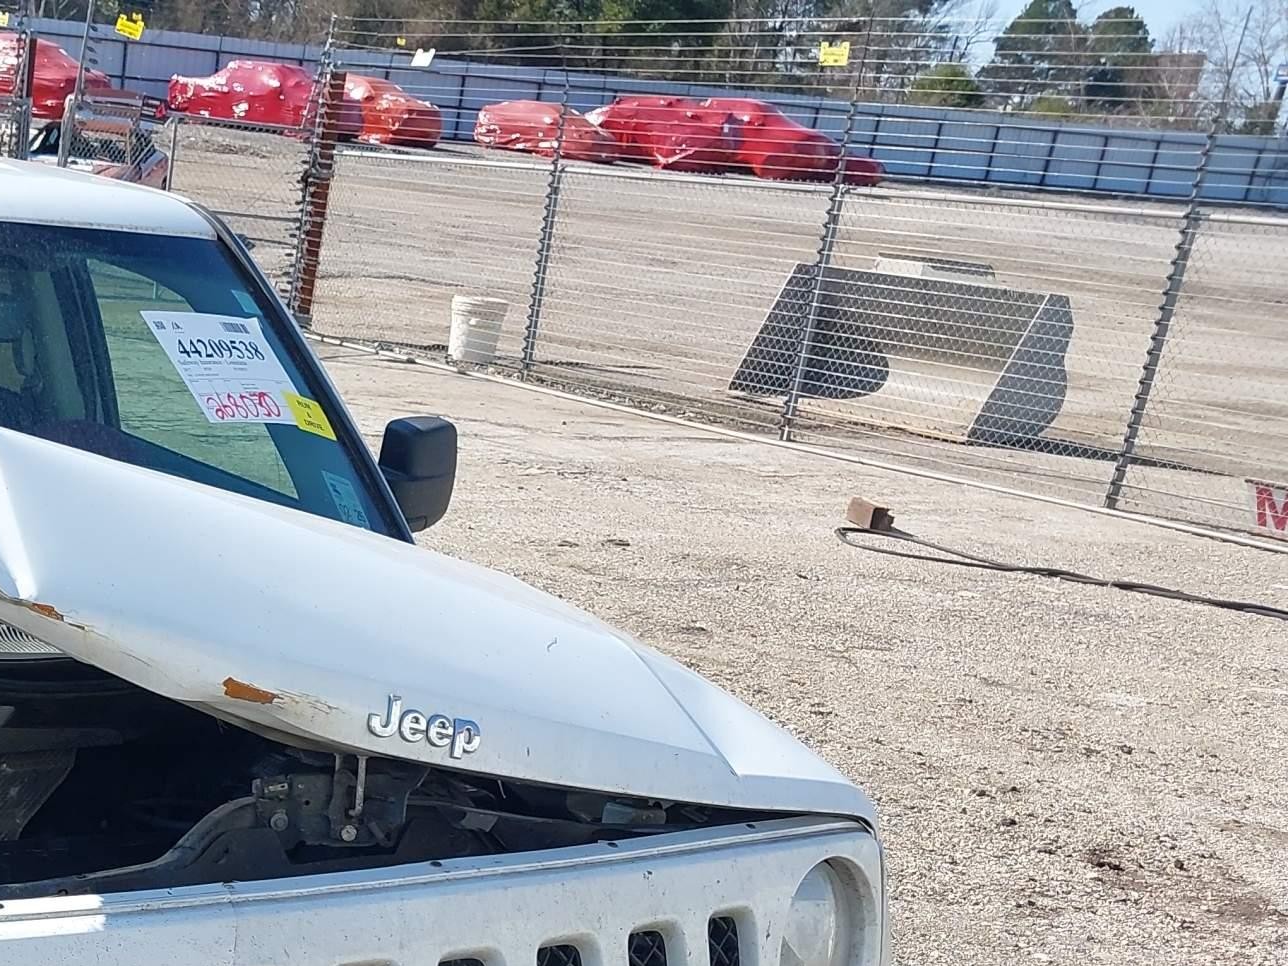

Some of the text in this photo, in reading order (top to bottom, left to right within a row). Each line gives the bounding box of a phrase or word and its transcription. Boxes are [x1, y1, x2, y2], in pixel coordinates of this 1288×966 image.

[177, 338, 265, 361] 44209538
[295, 399, 312, 411] RUN
[367, 693, 481, 760] Jeep
